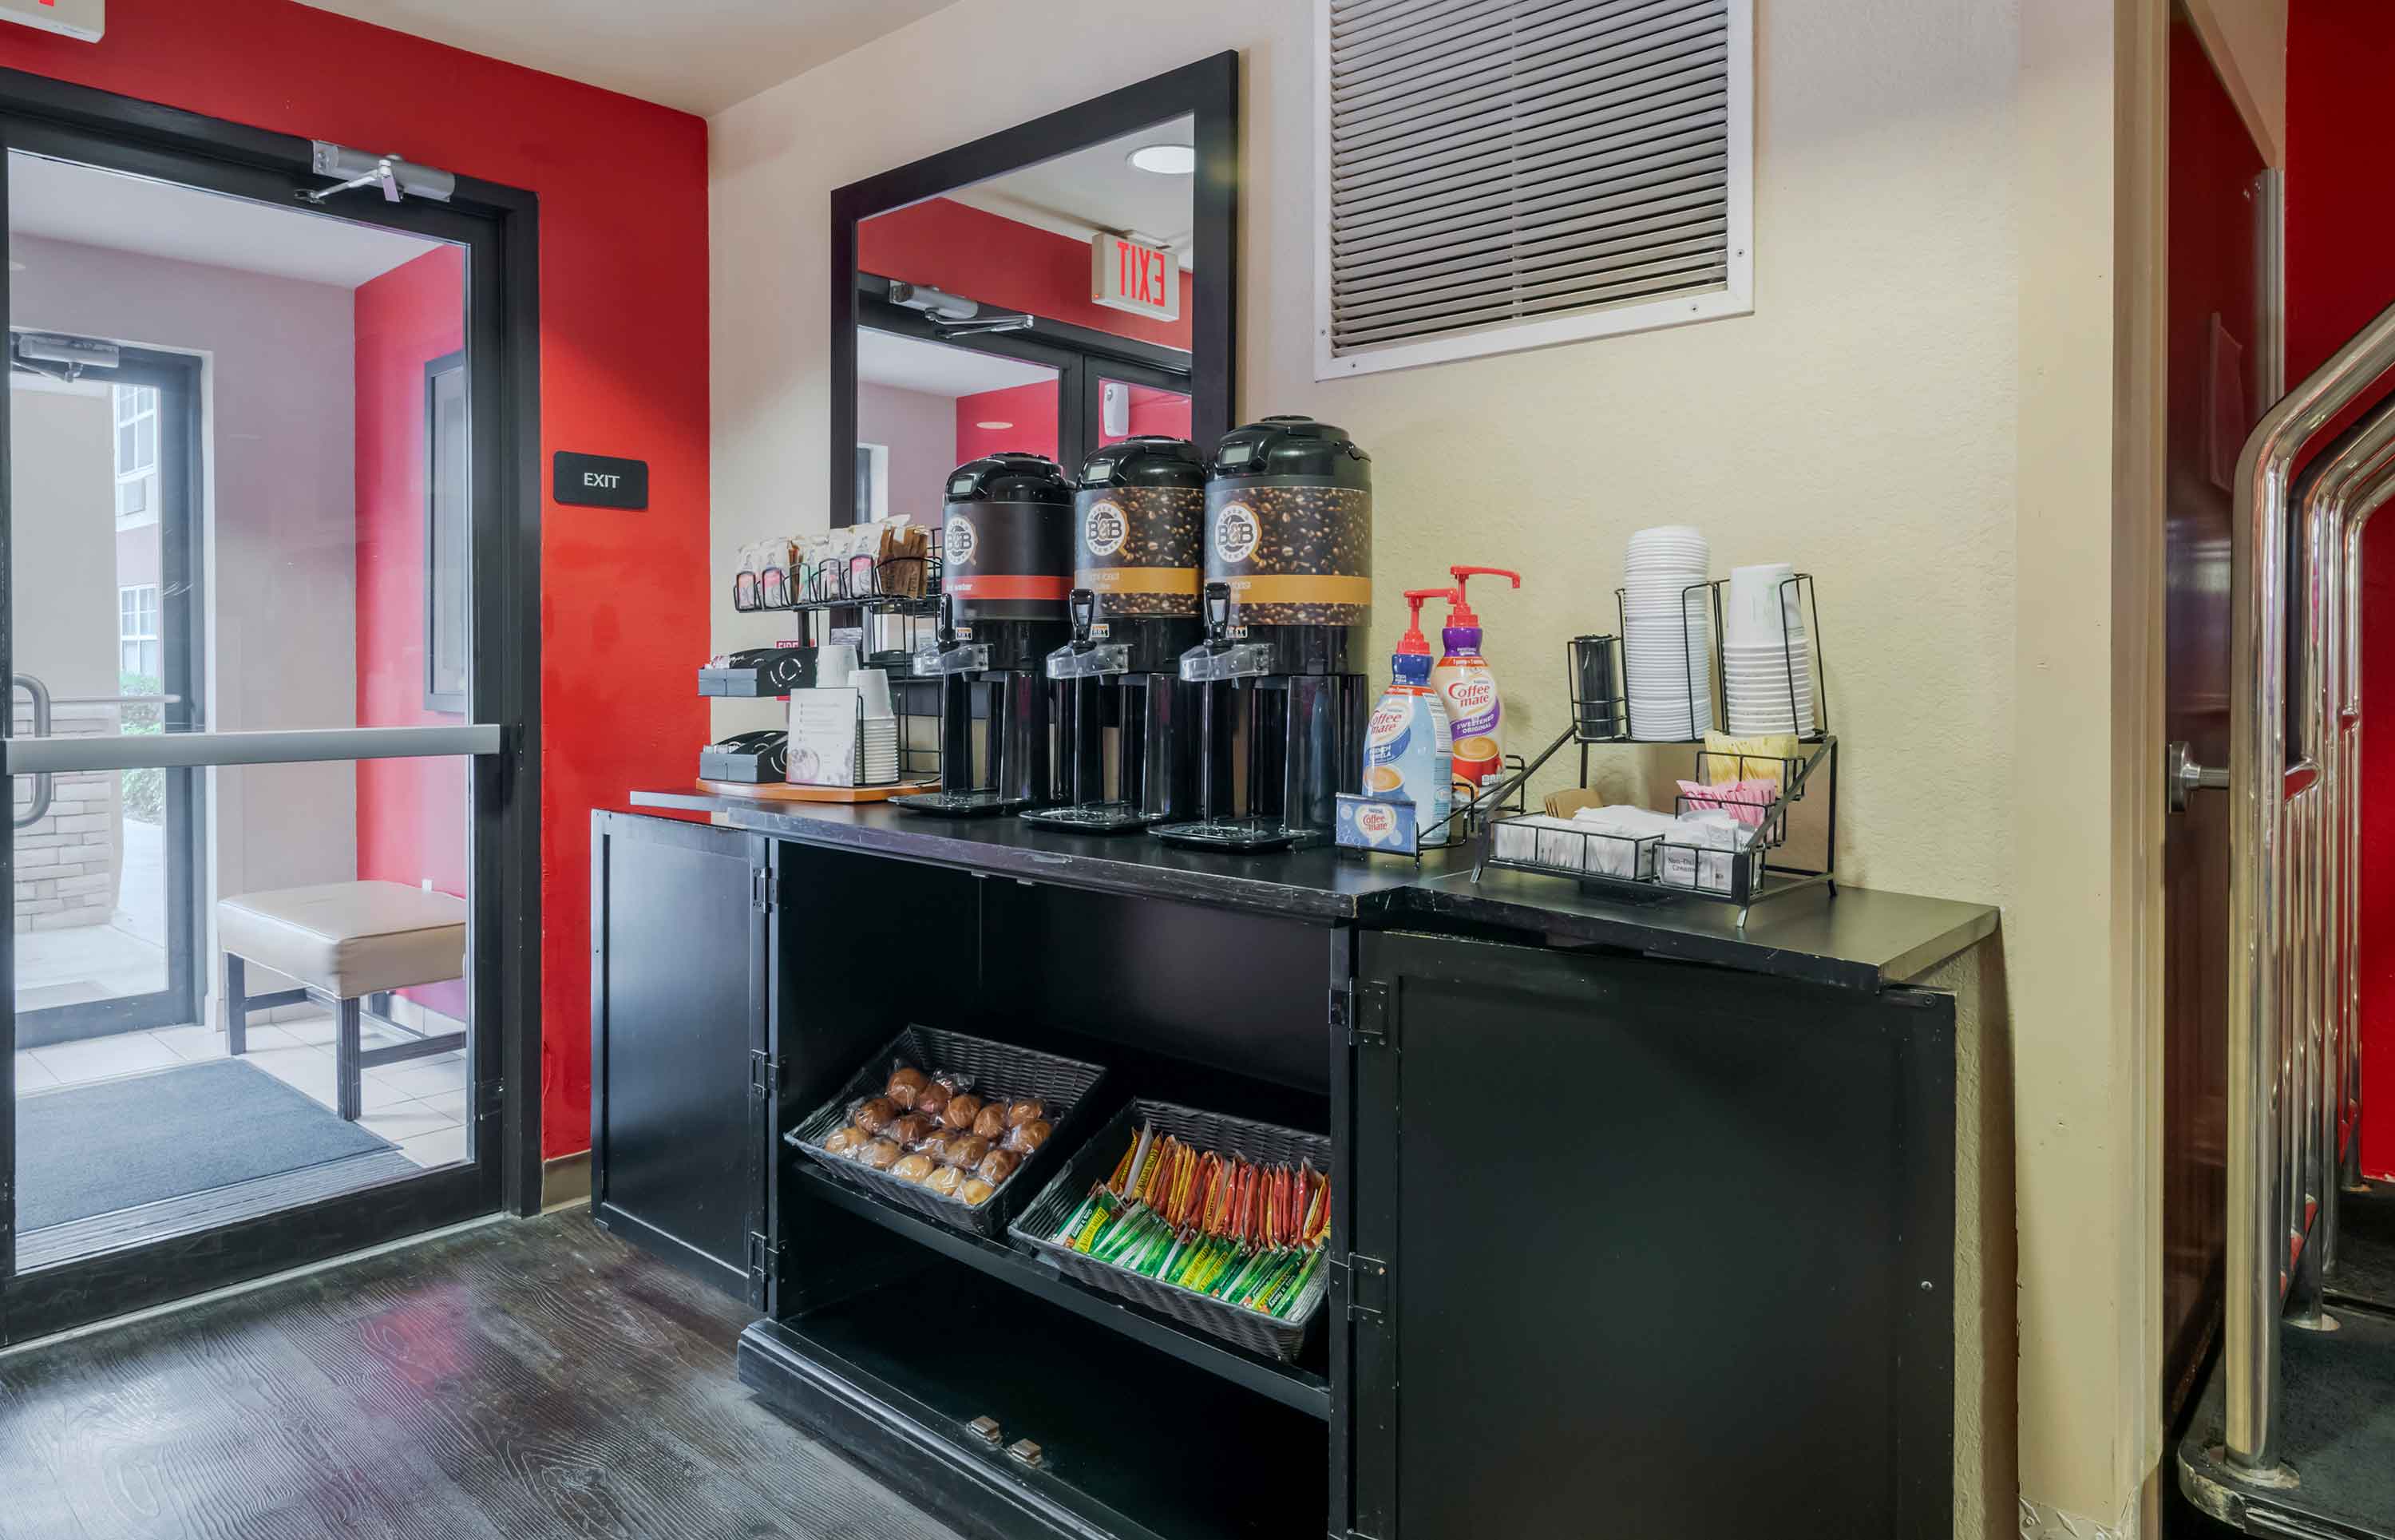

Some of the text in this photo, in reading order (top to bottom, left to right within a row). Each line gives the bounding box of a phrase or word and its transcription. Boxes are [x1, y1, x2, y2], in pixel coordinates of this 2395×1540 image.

[584, 473, 620, 489] EXIT
[1087, 519, 1122, 540] B&B
[1217, 523, 1254, 545] B&B
[1448, 683, 1490, 699] Coffee
[1460, 695, 1489, 707] mate
[1370, 710, 1402, 727] Coffee
[1457, 714, 1494, 730] SWEETENED
[1371, 723, 1396, 734] mate
[1463, 722, 1491, 734] ORIGINAL
[1363, 814, 1385, 825] Coffee
[1668, 857, 1702, 865] Non-Daiy
